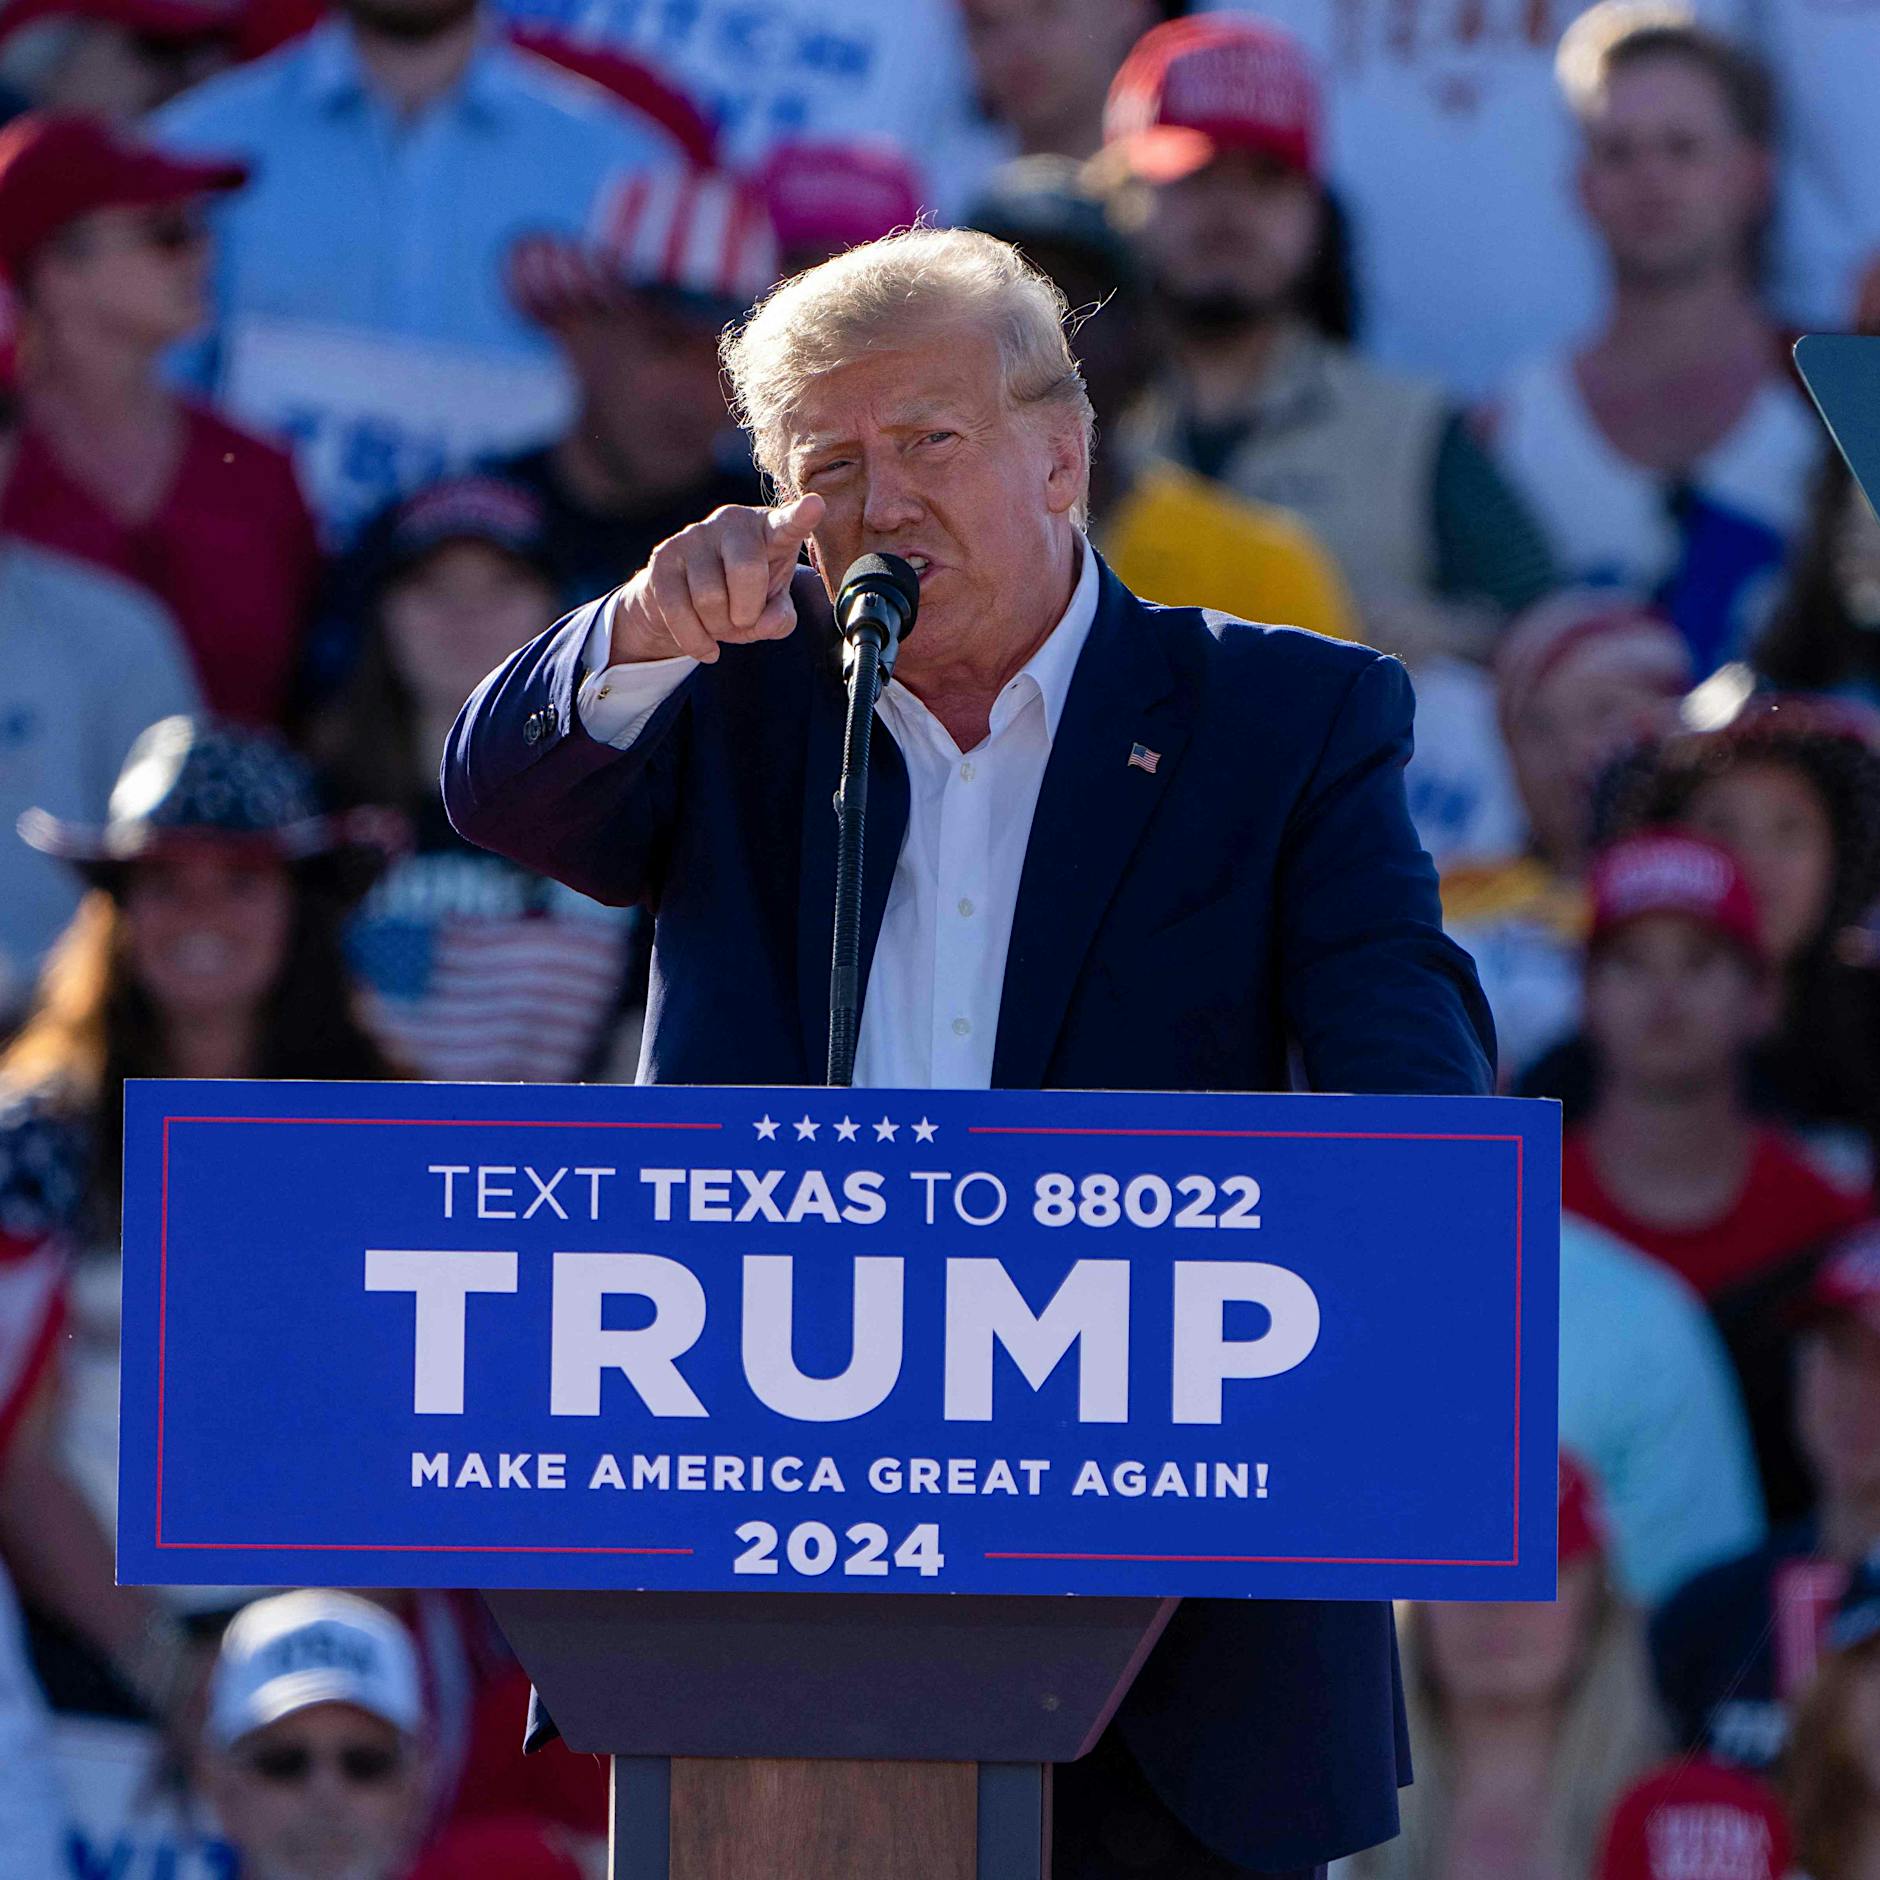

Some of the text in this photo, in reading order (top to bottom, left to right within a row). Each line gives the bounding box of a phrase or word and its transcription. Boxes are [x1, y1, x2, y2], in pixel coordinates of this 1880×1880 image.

[428, 1165, 1262, 1230] TEXT TEXAS TO 88022
[364, 1249, 1320, 1426] TRUMP
[411, 1452, 1269, 1499] MAKE AMERICA GREAT AGAIN!
[733, 1520, 946, 1577] 2024
